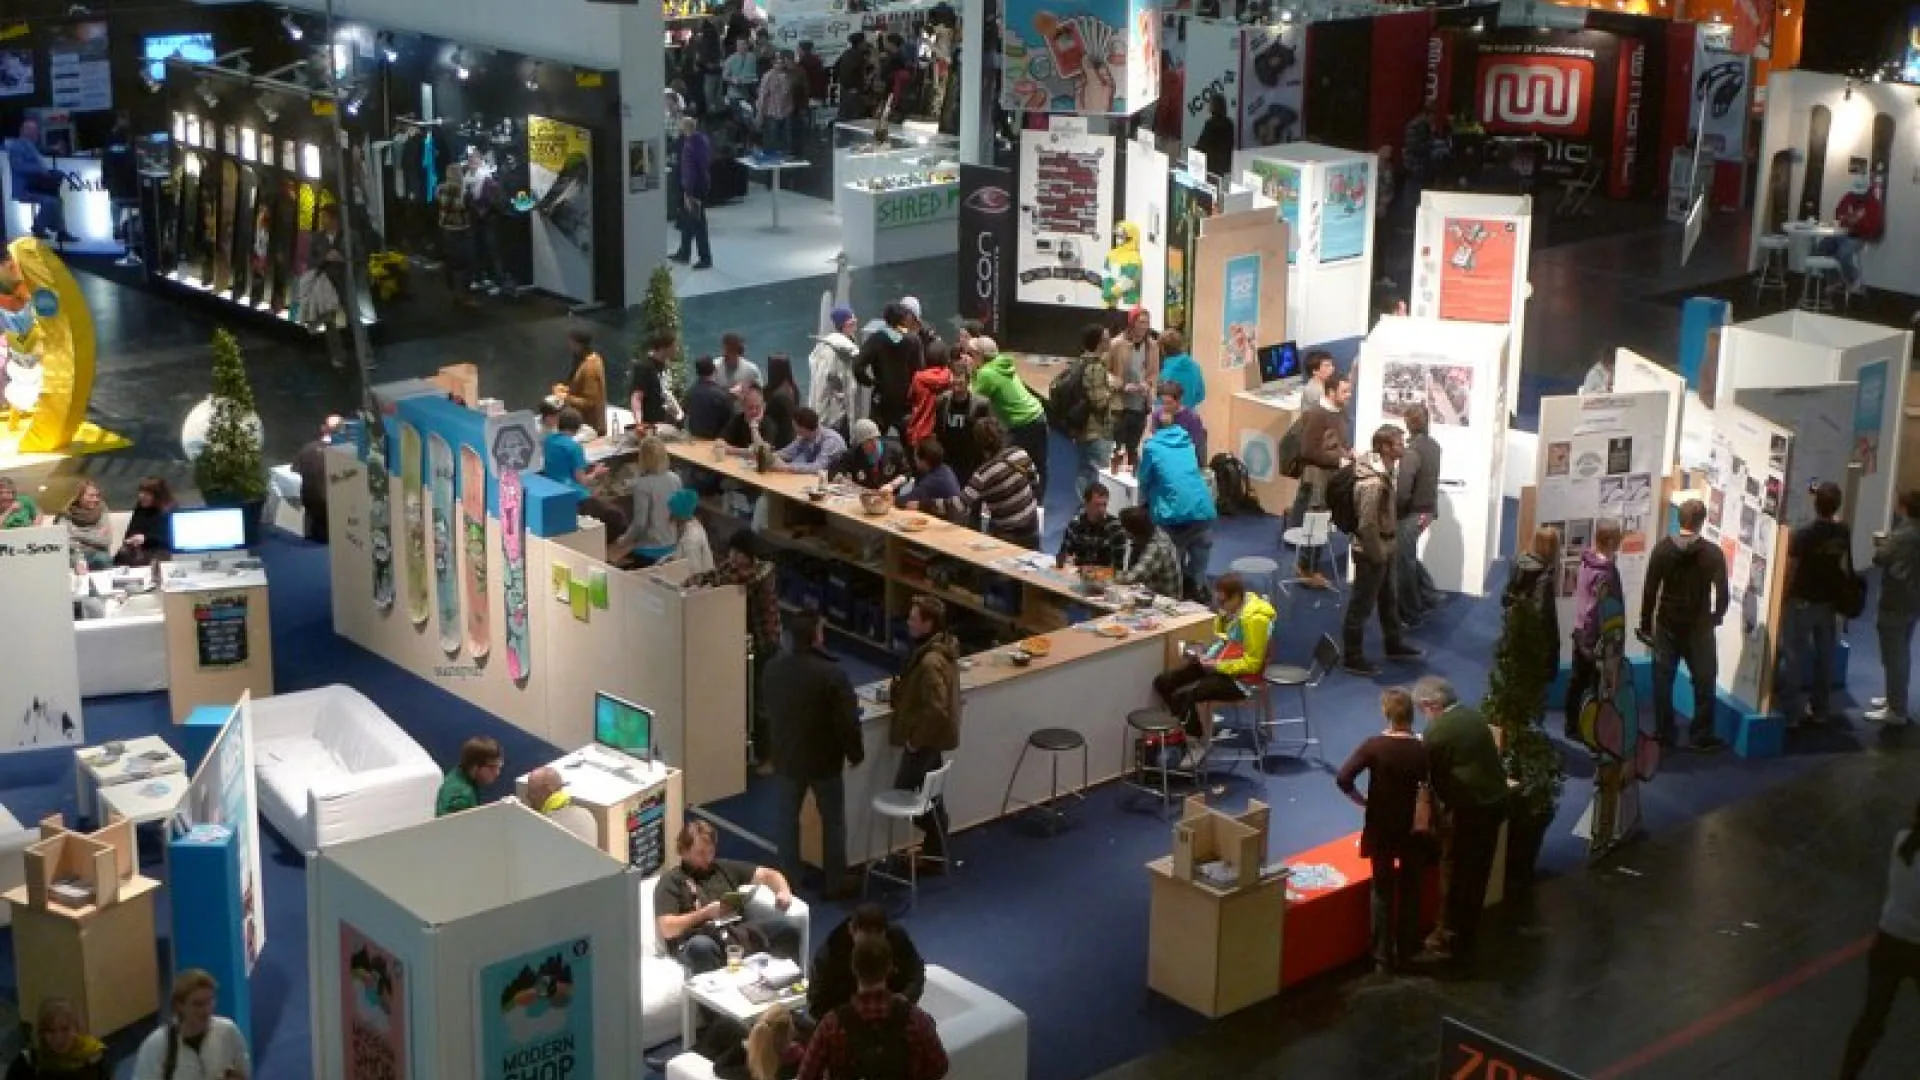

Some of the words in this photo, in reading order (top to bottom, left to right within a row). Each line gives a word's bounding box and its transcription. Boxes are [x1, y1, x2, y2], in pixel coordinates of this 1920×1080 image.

[877, 191, 942, 222] SHRED
[503, 1035, 575, 1072] MODERN
[504, 1055, 575, 1080] HOP
